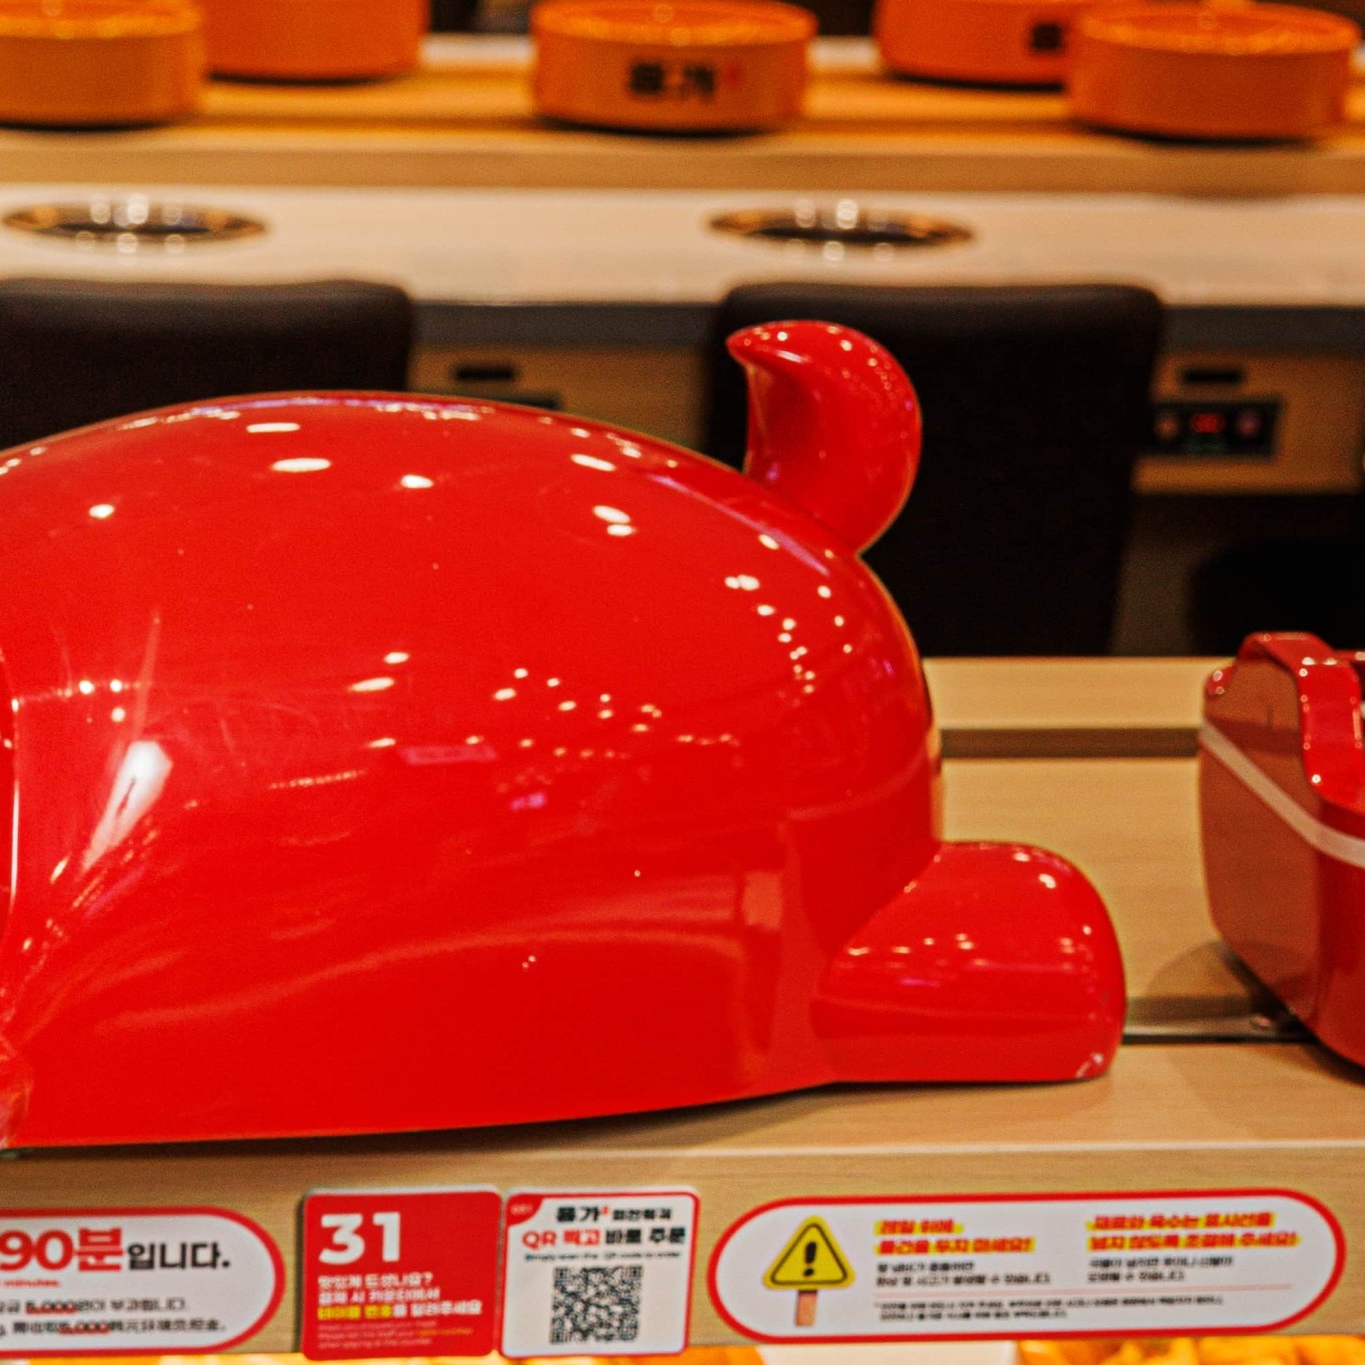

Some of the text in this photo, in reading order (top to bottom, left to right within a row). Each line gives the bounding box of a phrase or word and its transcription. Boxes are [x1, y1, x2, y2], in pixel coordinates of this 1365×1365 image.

[318, 1211, 401, 1265] 31
[522, 1230, 557, 1250] QR
[606, 1228, 642, 1244] 바로
[650, 1227, 686, 1244] 주문
